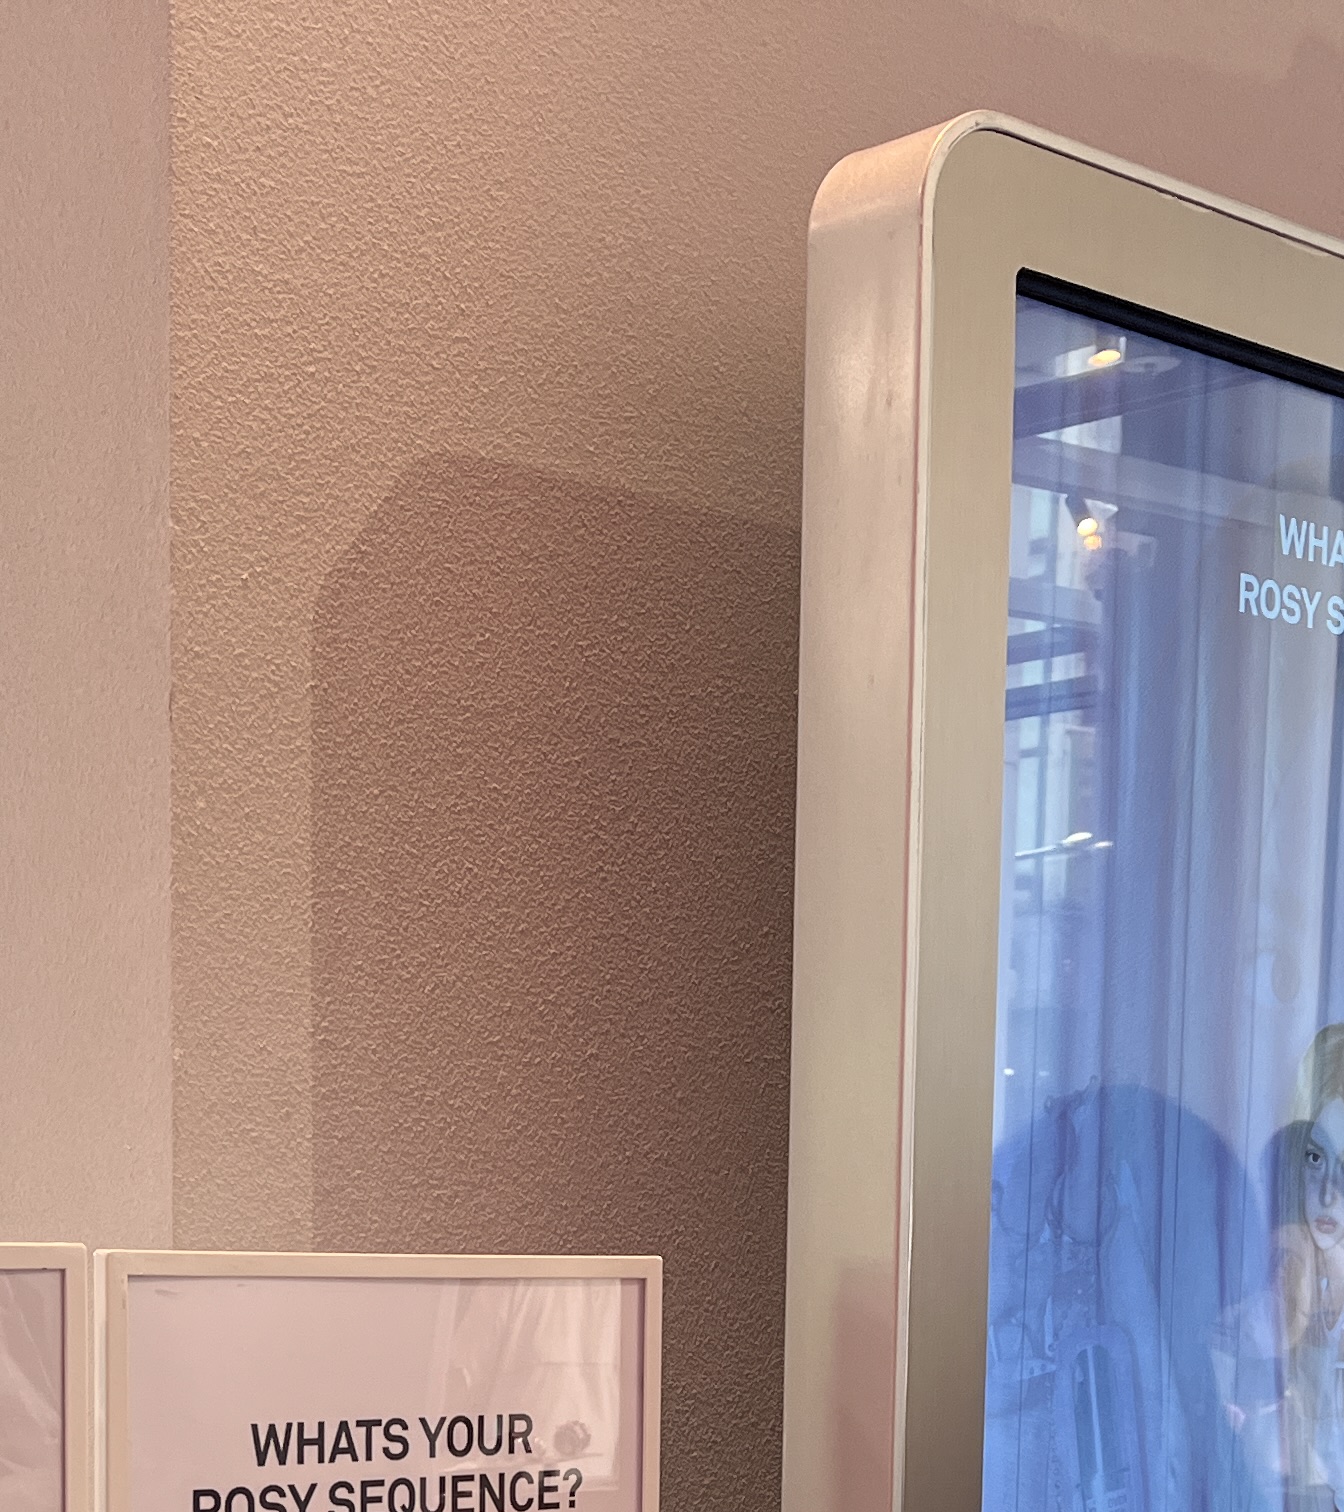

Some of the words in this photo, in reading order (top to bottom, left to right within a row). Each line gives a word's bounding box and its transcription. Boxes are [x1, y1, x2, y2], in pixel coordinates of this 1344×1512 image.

[1238, 572, 1322, 629] ROSY
[250, 1417, 410, 1468] WHATS
[419, 1413, 533, 1459] YOUR
